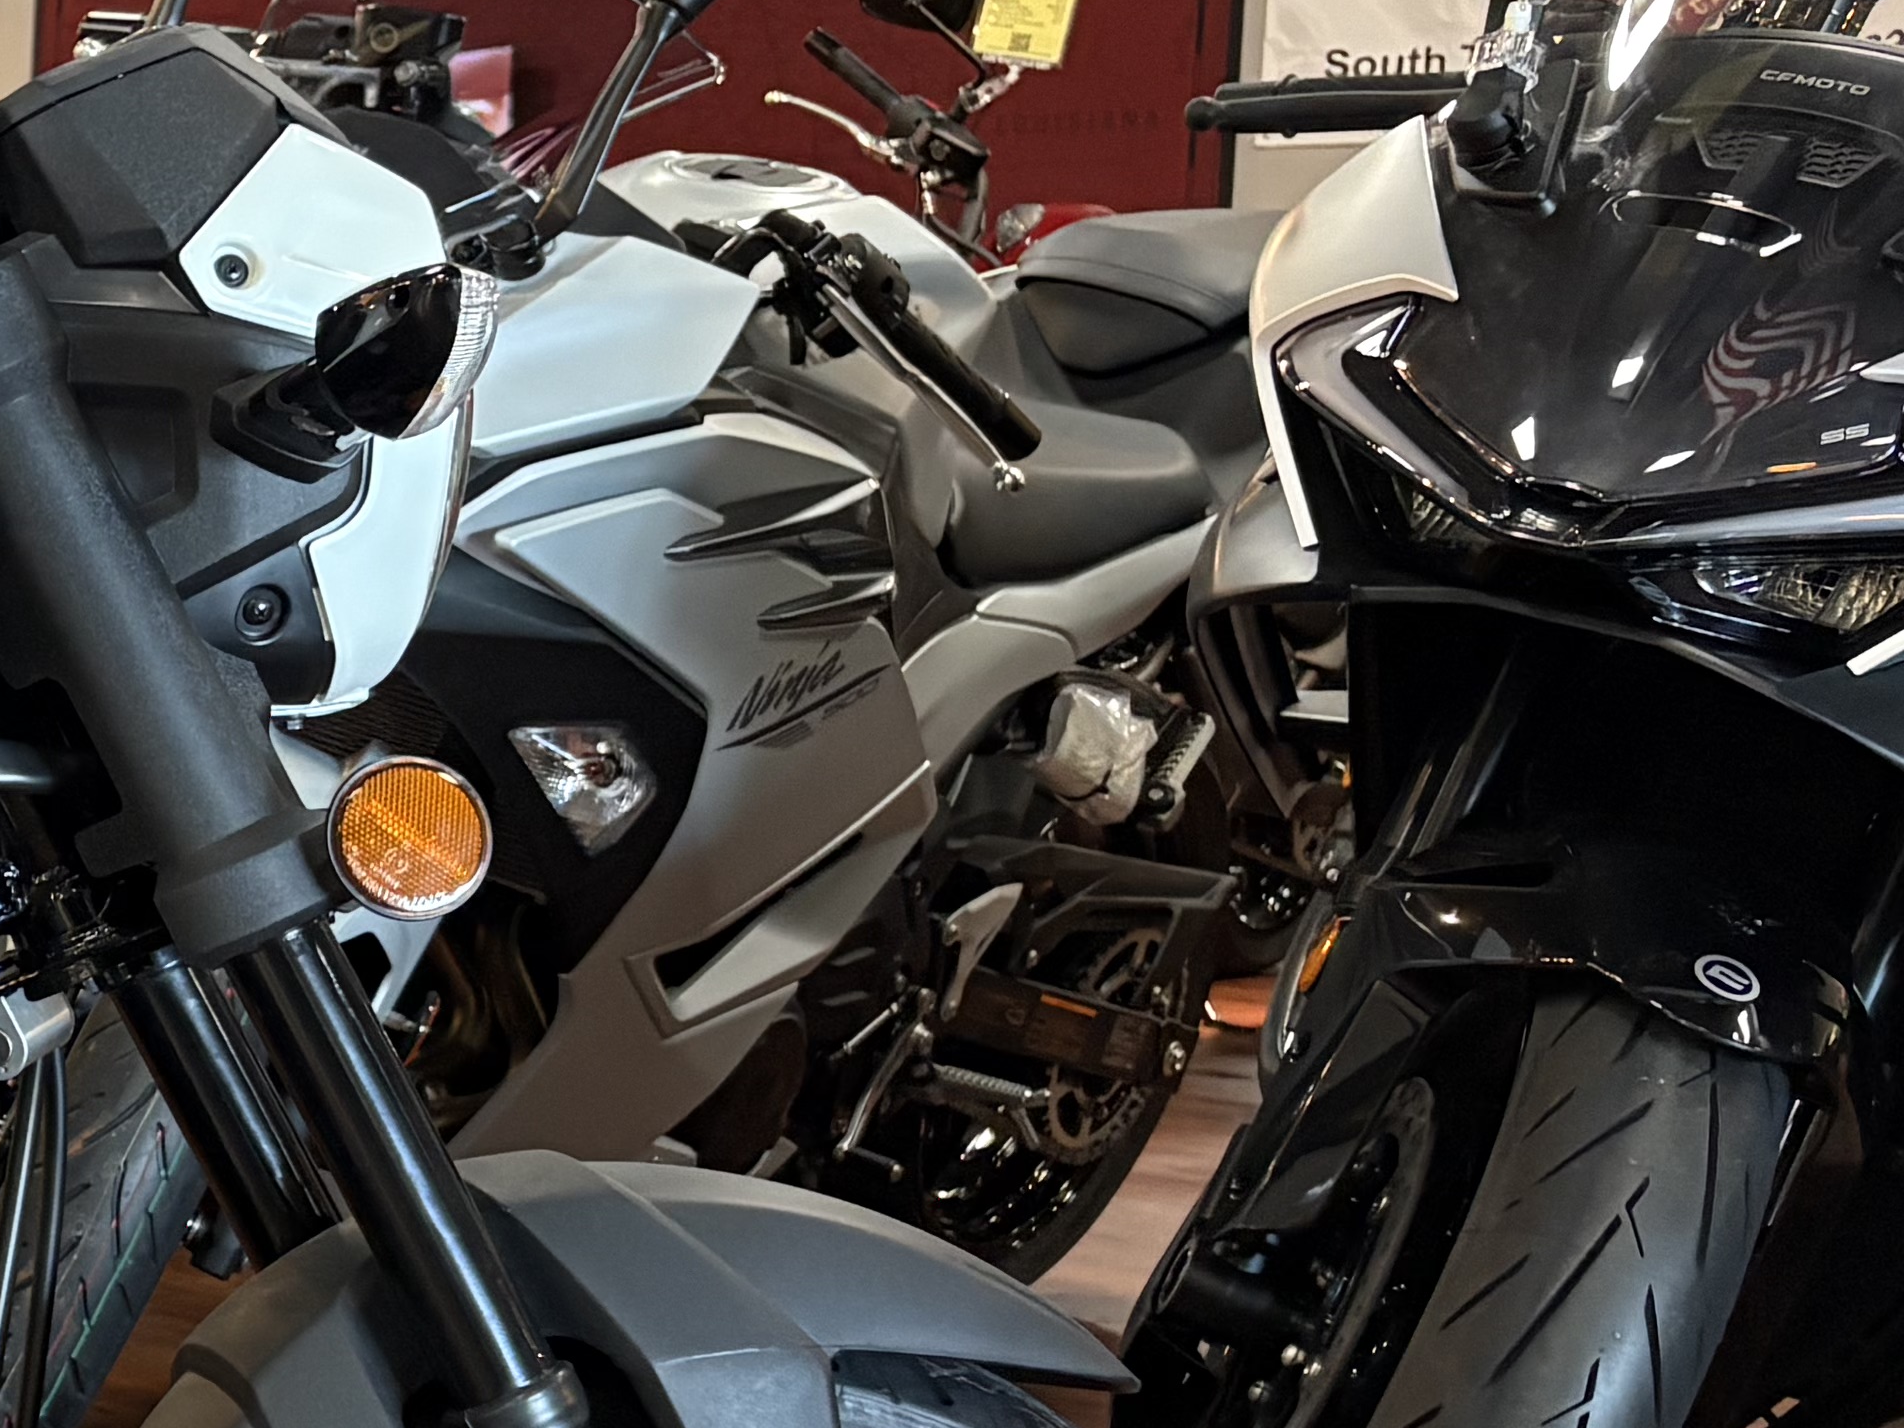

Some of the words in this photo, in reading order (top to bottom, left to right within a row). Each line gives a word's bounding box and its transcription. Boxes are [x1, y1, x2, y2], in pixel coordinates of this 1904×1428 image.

[1324, 45, 1445, 79] South
[1759, 69, 1871, 96] CFMOTO
[1820, 422, 1870, 446] SS
[725, 639, 845, 732] Ninja
